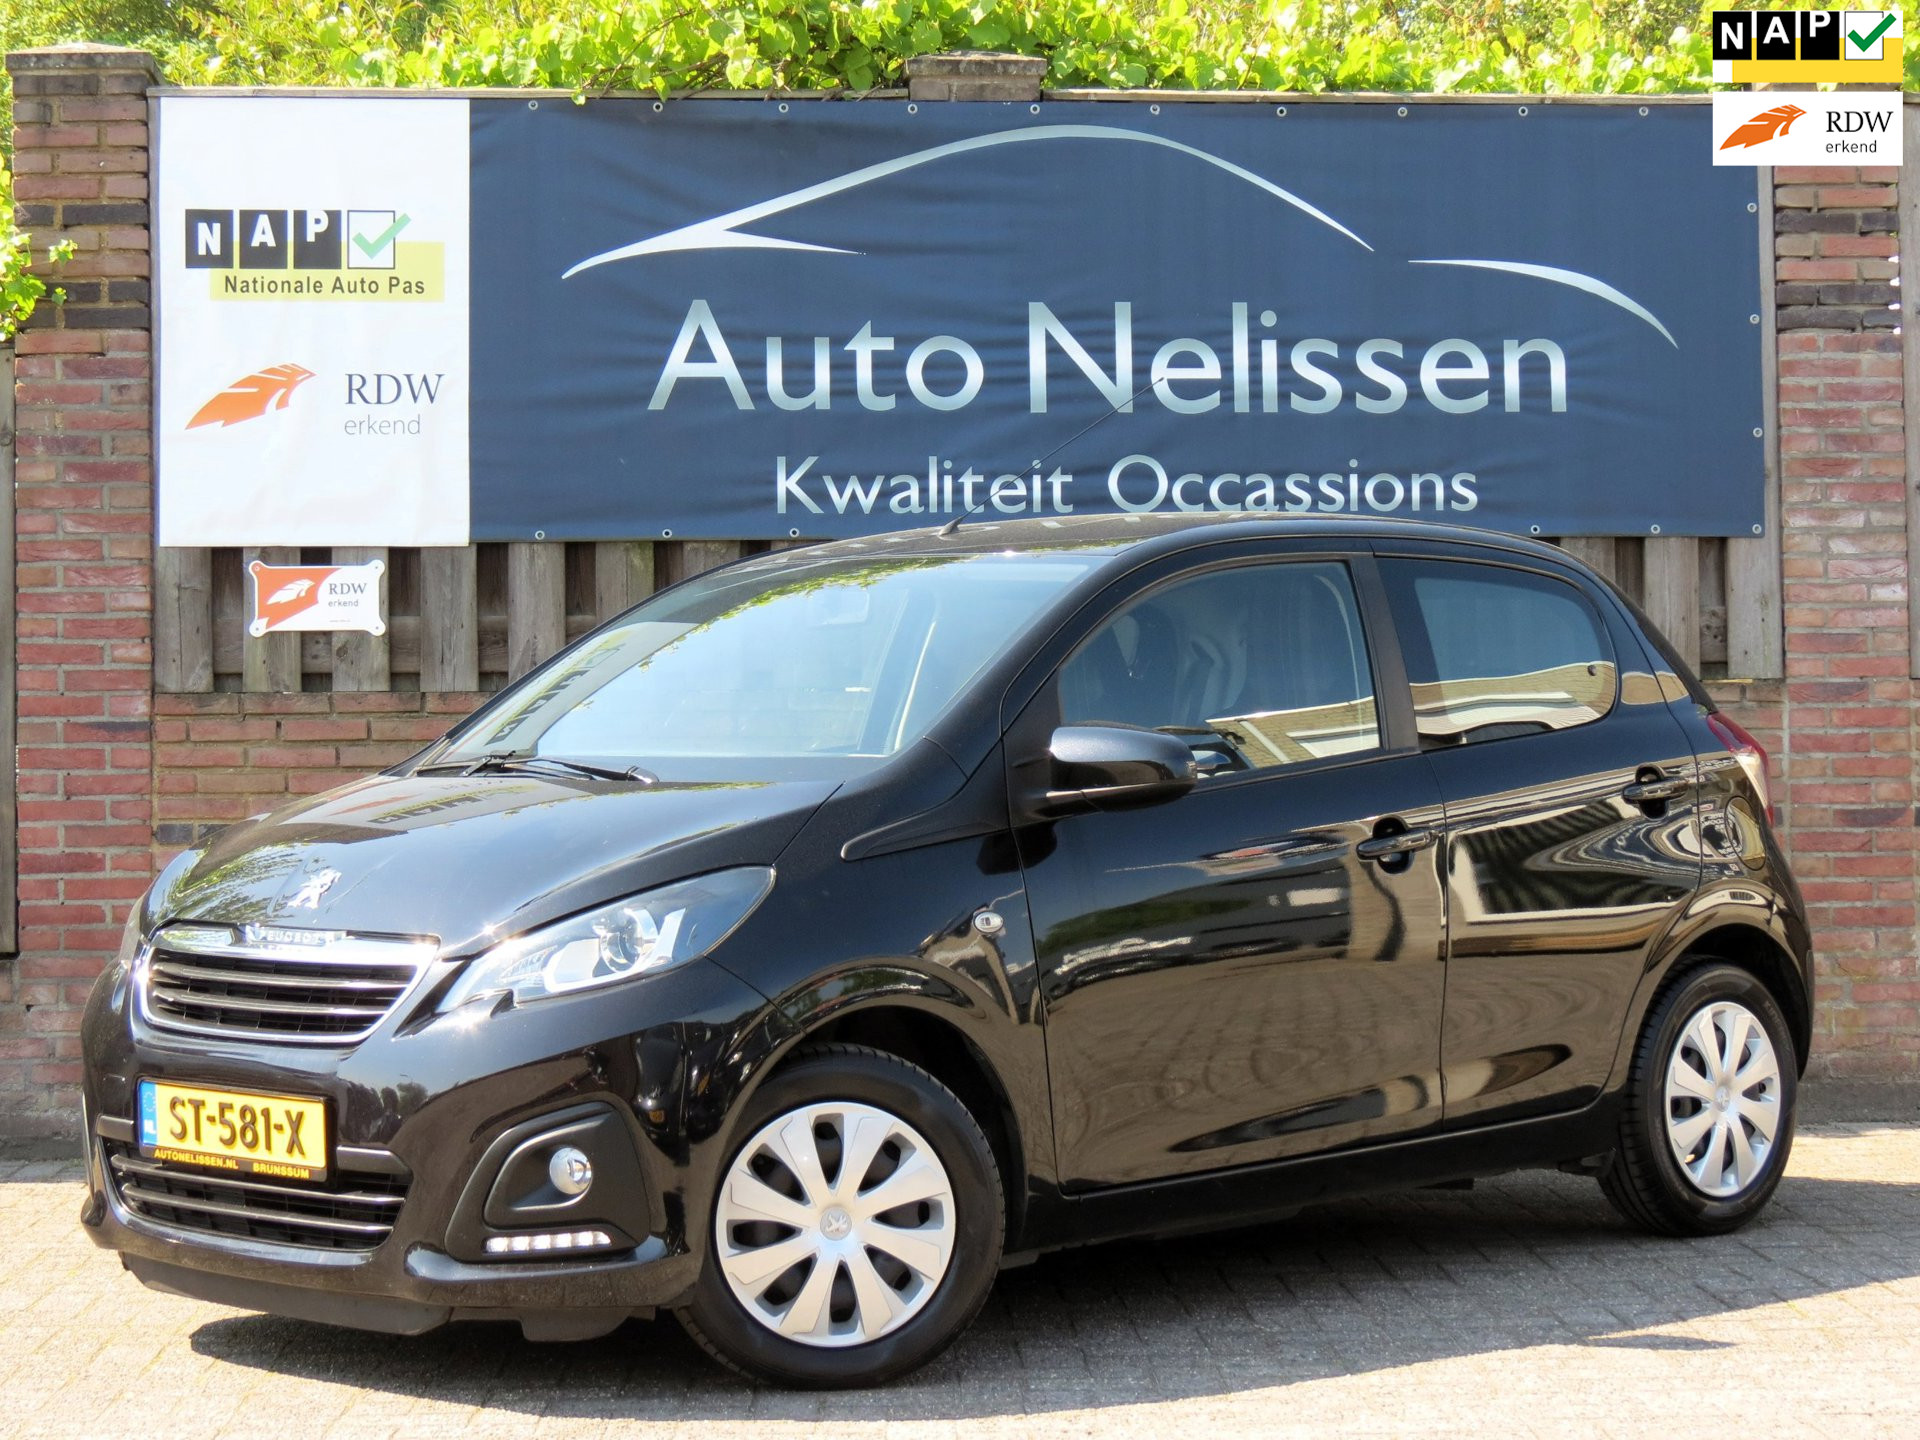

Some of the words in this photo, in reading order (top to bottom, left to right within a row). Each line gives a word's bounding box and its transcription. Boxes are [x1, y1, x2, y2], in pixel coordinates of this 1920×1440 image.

[197, 210, 328, 255] NAP
[224, 275, 323, 295] Nationale
[331, 276, 379, 295] Auto
[389, 276, 425, 295] Pas
[647, 299, 985, 412] Auto
[1029, 301, 1567, 414] Nelissen
[345, 373, 445, 405] RDW
[344, 415, 421, 435] erkend
[776, 455, 1074, 514] Kwaliteit
[1107, 454, 1478, 513] Occassions
[328, 583, 367, 595] RDW
[328, 599, 359, 607] erkend
[169, 1095, 306, 1156] ST-581-X
[154, 1148, 239, 1170] AUTONELISSEN.NL
[252, 1163, 310, 1180] BRUNSSUM
